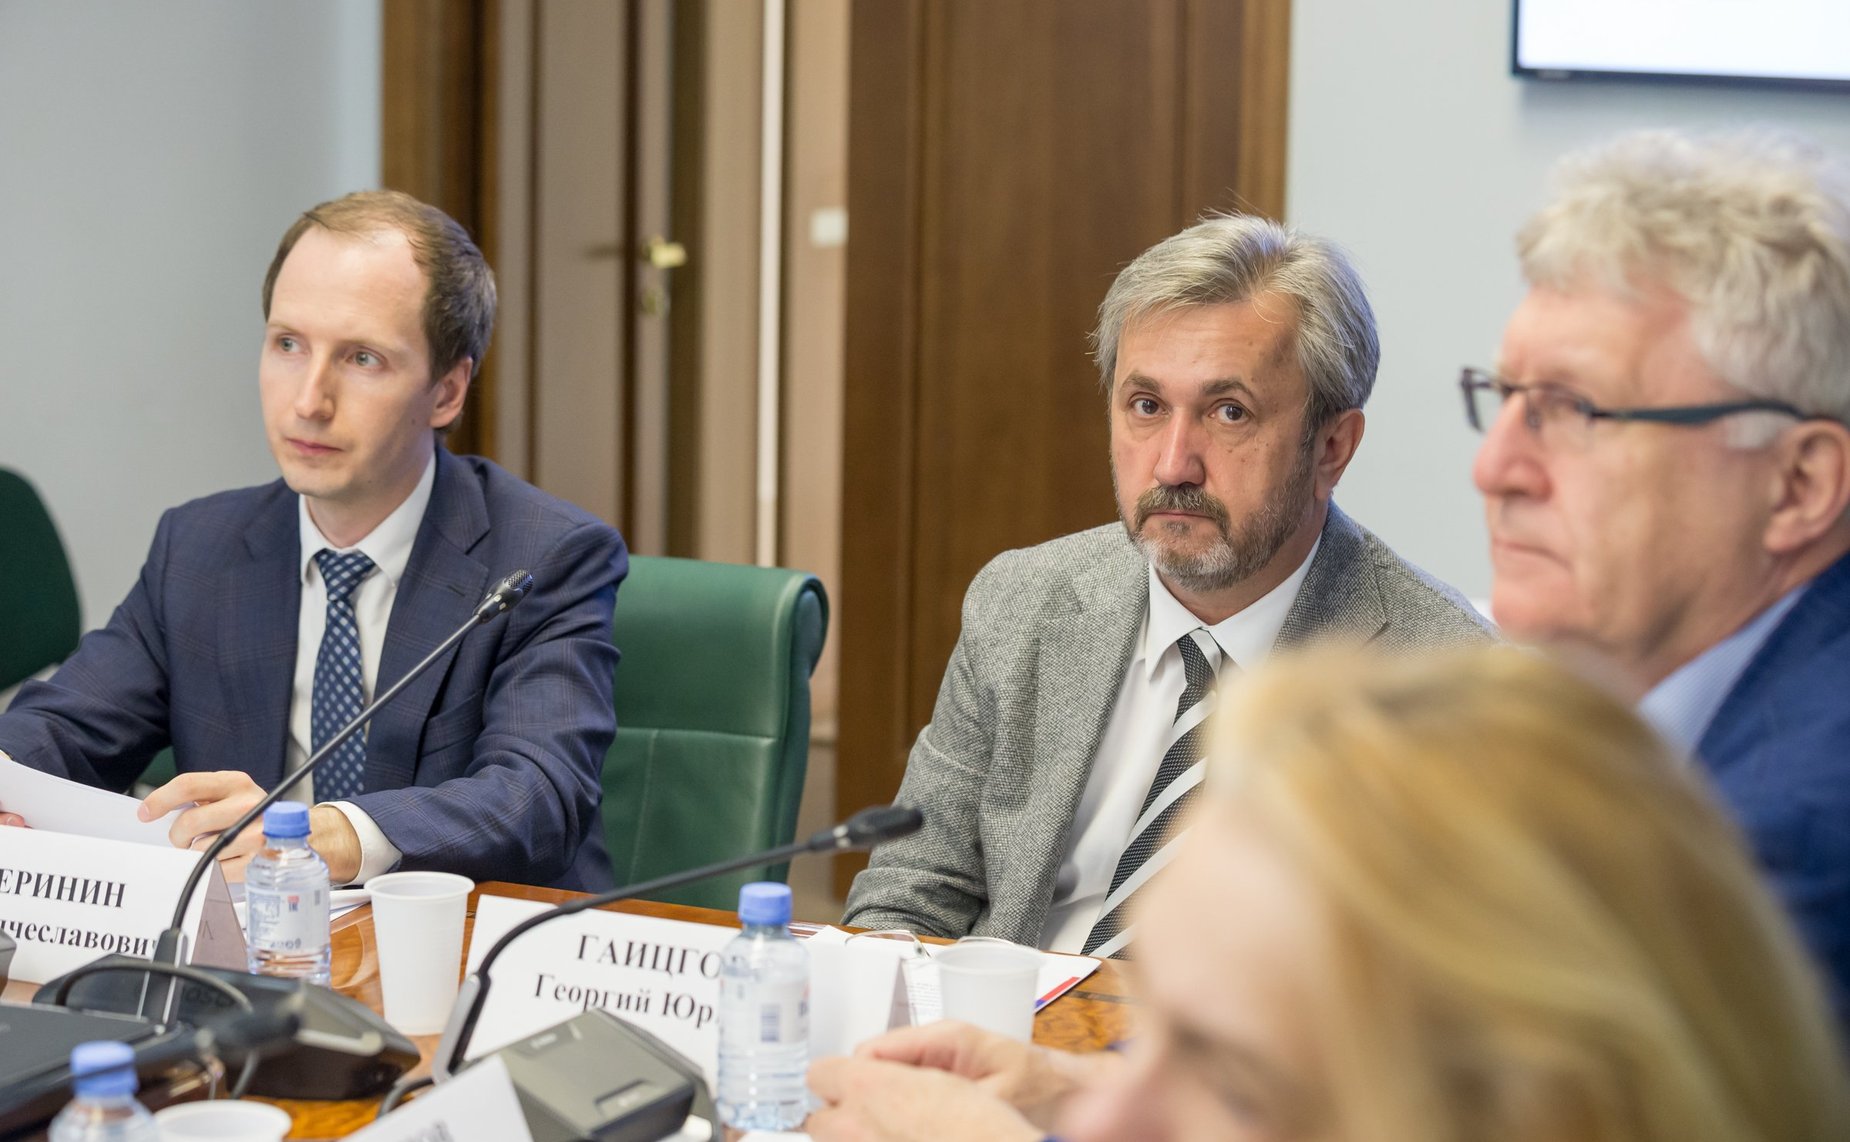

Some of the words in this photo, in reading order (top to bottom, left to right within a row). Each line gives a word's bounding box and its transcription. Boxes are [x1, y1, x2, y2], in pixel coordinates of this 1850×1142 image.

[0, 919, 157, 956] чеславови
[576, 934, 728, 980] ГАИЦГО
[534, 973, 651, 1013] Георгий
[661, 991, 719, 1029] Юр
